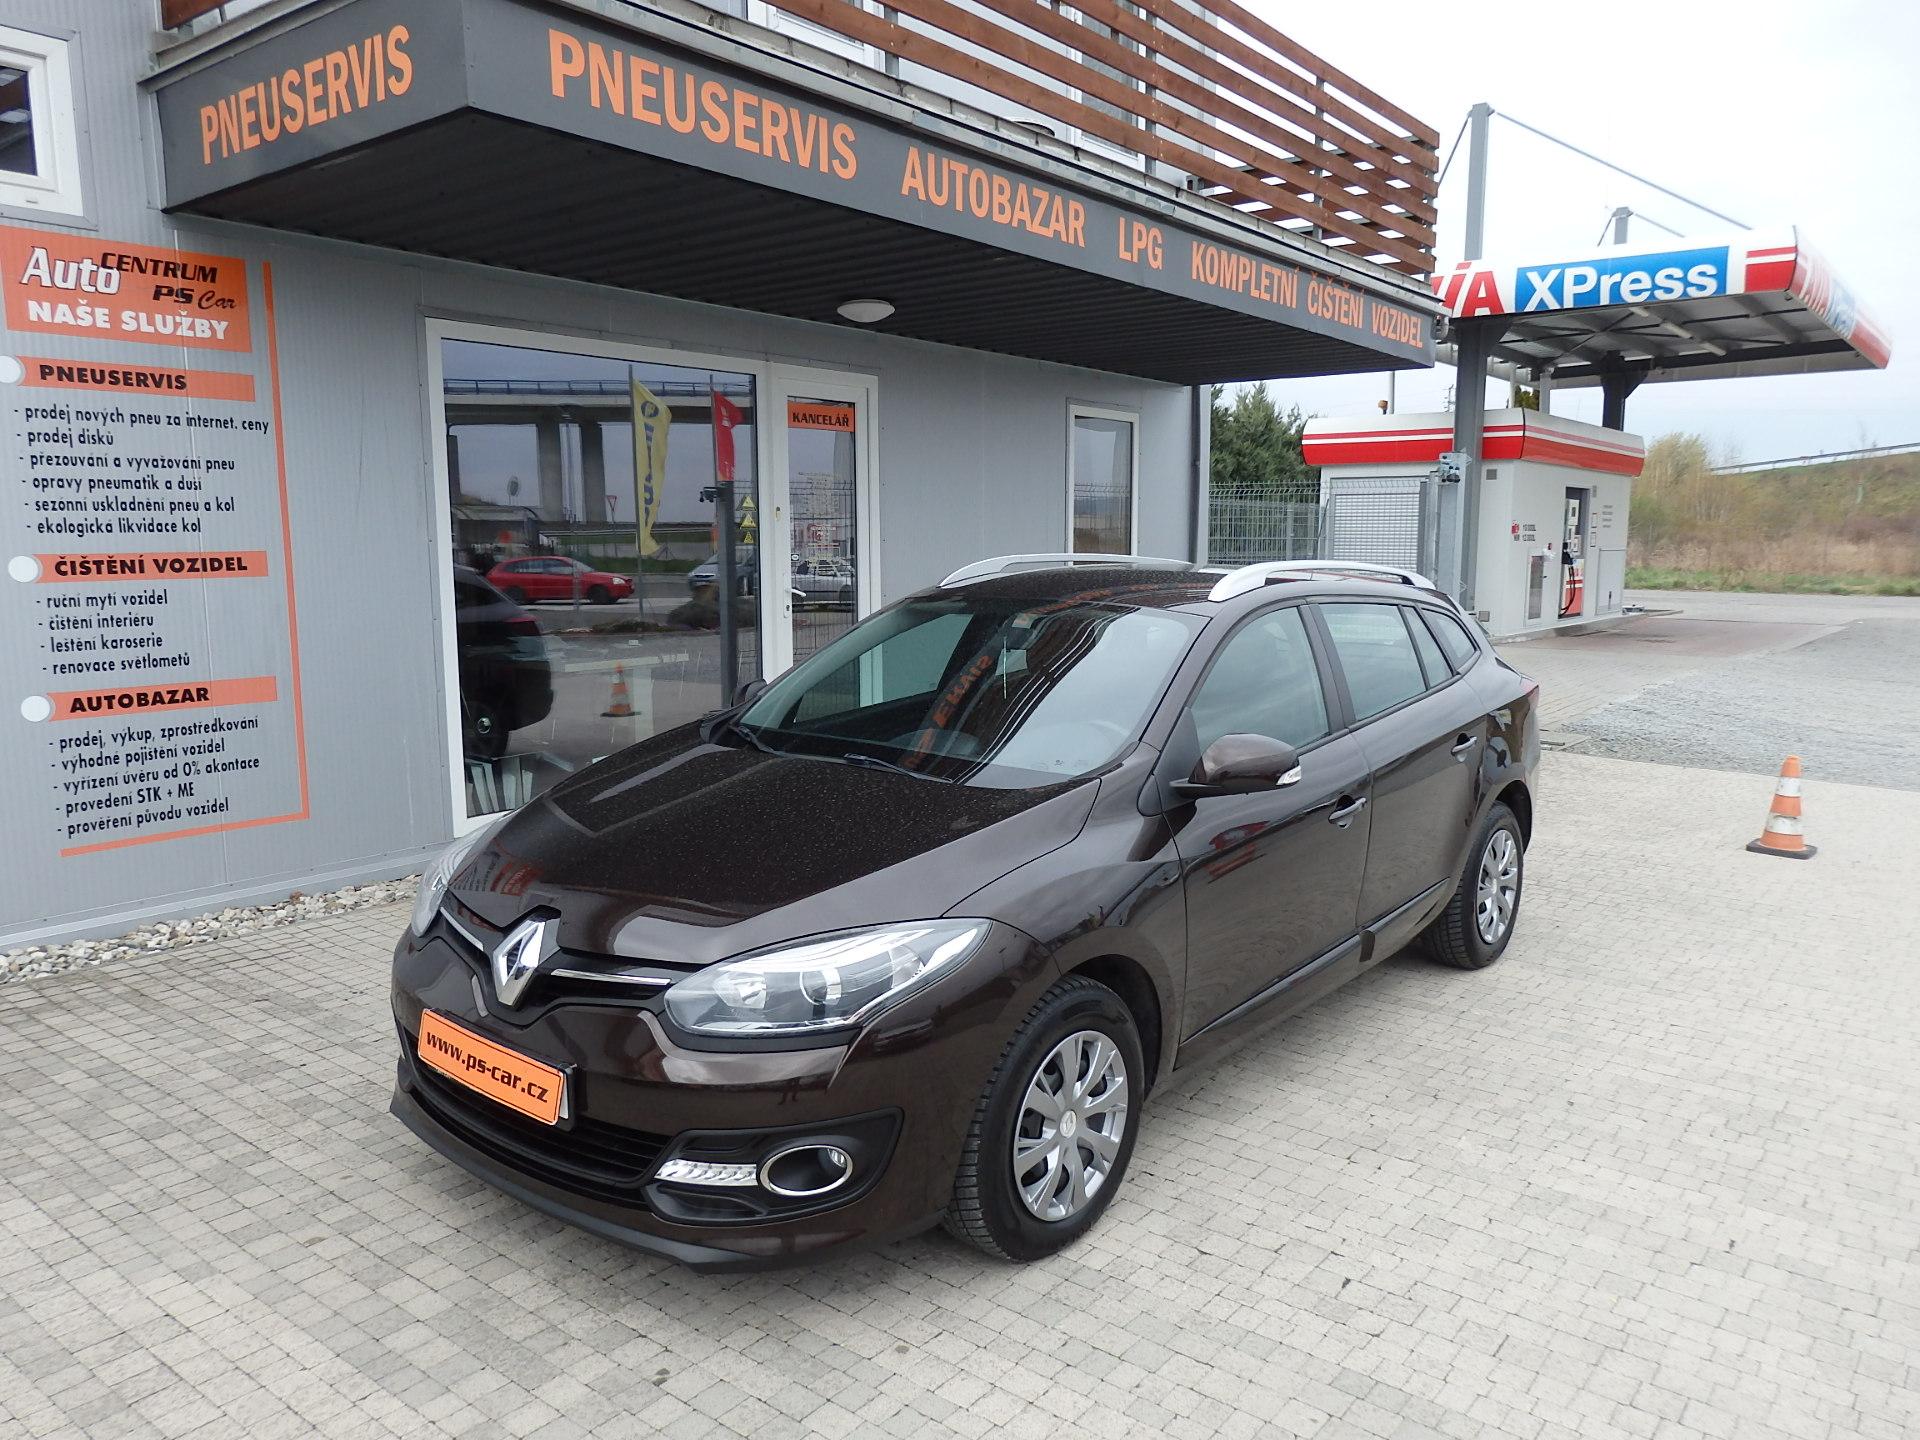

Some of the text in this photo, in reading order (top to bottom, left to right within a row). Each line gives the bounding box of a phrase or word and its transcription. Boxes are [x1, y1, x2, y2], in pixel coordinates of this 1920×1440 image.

[200, 25, 413, 165] PNEUSERVIS
[548, 28, 1423, 348] PNEUSERVIS AUTOBAZAR LPG KOMPLETNÍ ČIŠTĚNÍ VOZIDEL
[20, 246, 218, 295] Auto CENTRUM
[152, 285, 236, 310] PS Car
[1524, 264, 1718, 313] XPress
[27, 298, 229, 340] NAŠE SLUŽBY
[39, 364, 187, 390] PNEUSERVIS
[25, 403, 269, 434] prodej nových pneu za internet. ceny
[792, 411, 849, 427] KANCELÁŘ
[27, 426, 114, 448] prodej disků
[30, 452, 235, 474] přezouvání a vyvažování pneu
[32, 474, 202, 493] opravy pneumatik a duší
[35, 495, 235, 515] sezónní uskladnění pneu a kol
[37, 517, 201, 537] ekologická likvidace kol
[54, 555, 248, 577] ČIŠTĚNÍ VOZIDEL
[47, 592, 81, 608] ruční
[121, 588, 168, 605] vozidel
[49, 611, 154, 630] čištění interiéru
[51, 632, 163, 652] leštění karoserie
[53, 652, 190, 674] renovace světlometů
[70, 687, 210, 713] AUTOBAZAR
[60, 715, 259, 753] prodej, výkup, zprostředkování
[125, 745, 178, 767] pojištění
[182, 737, 225, 756] vozidel
[64, 758, 260, 795] vyřízení úvěru od 0% akontace
[66, 792, 133, 818] provedení
[137, 786, 162, 804] STK
[178, 782, 195, 798] ME
[67, 797, 229, 839] prověření původu vozidel
[426, 1031, 549, 1103] www.ps-car.cz
